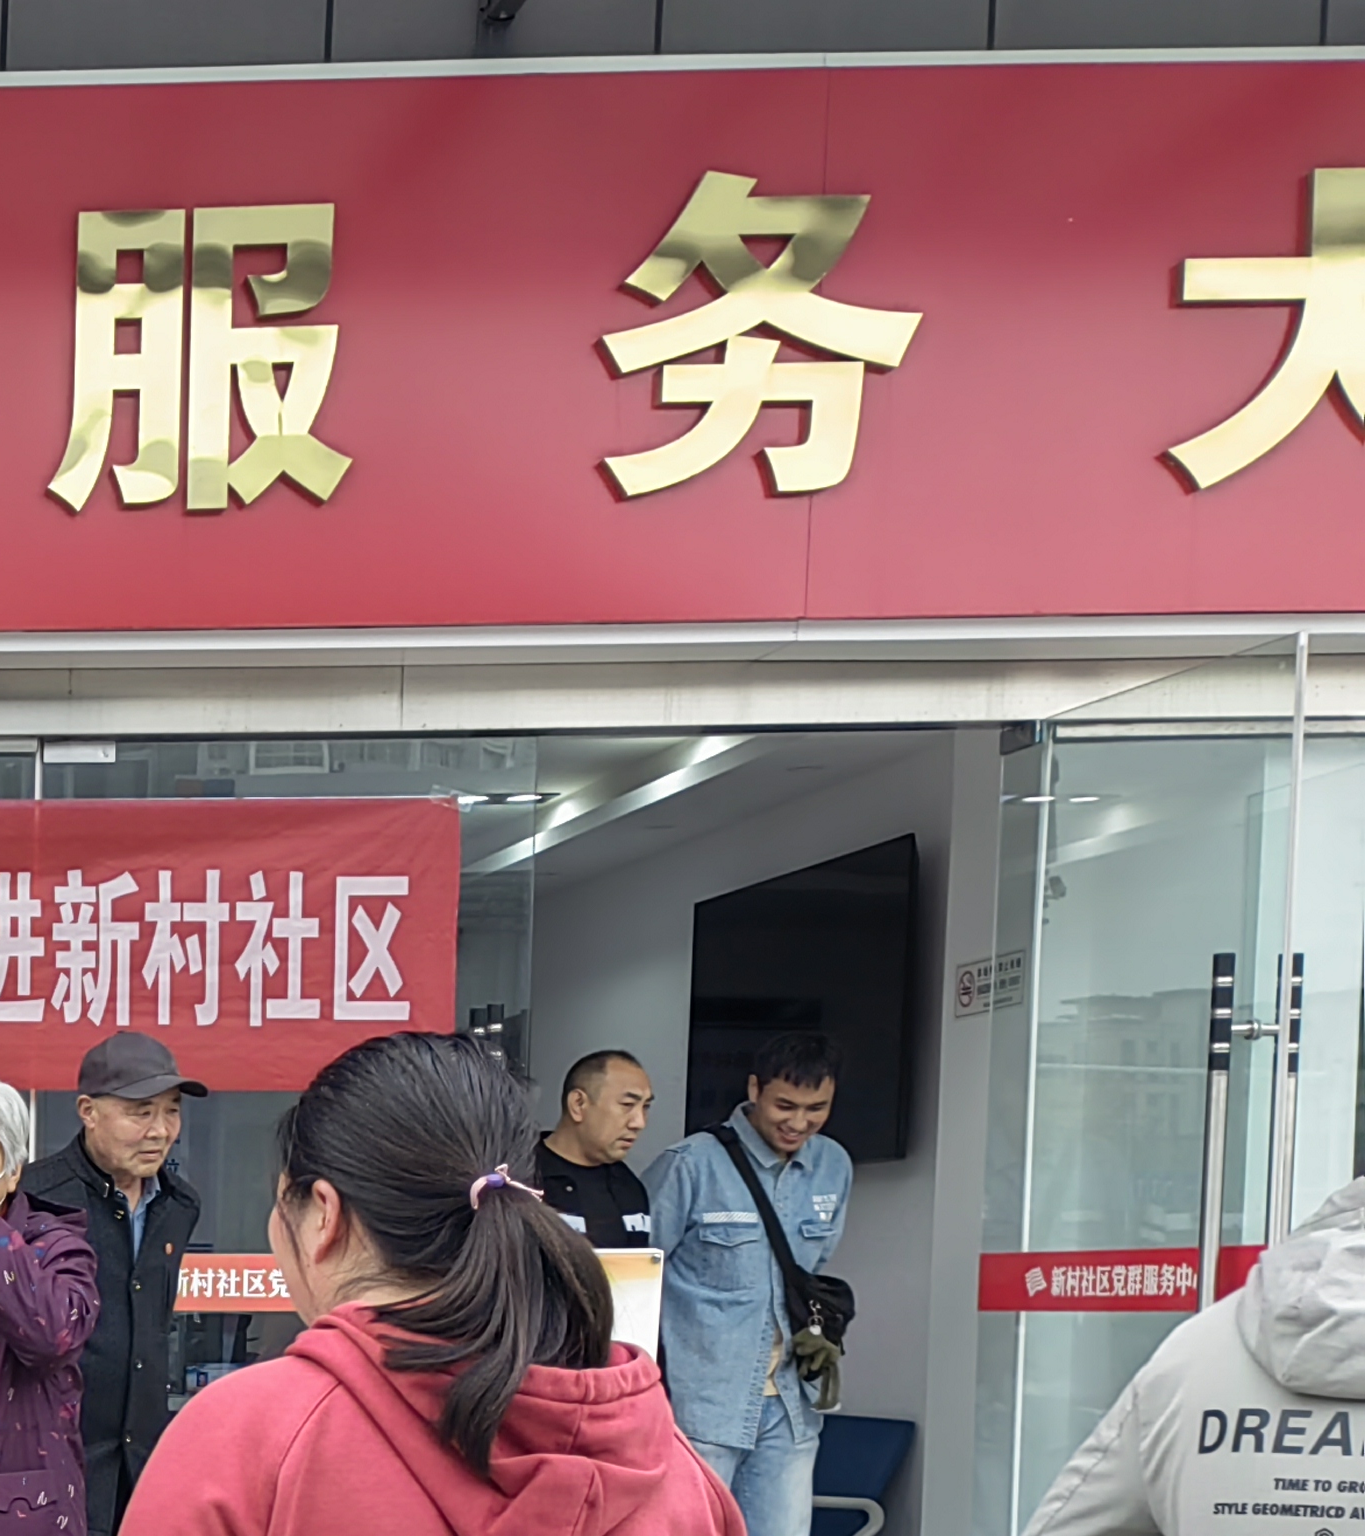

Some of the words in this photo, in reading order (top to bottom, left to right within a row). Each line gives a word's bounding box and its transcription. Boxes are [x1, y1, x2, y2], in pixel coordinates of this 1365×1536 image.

[1051, 1263, 1198, 1297] 新村社区党群服务中
[1198, 1408, 1365, 1457] DREA
[1273, 1478, 1309, 1491] TIME
[1314, 1480, 1332, 1492] TO
[1213, 1503, 1248, 1515] STYLE
